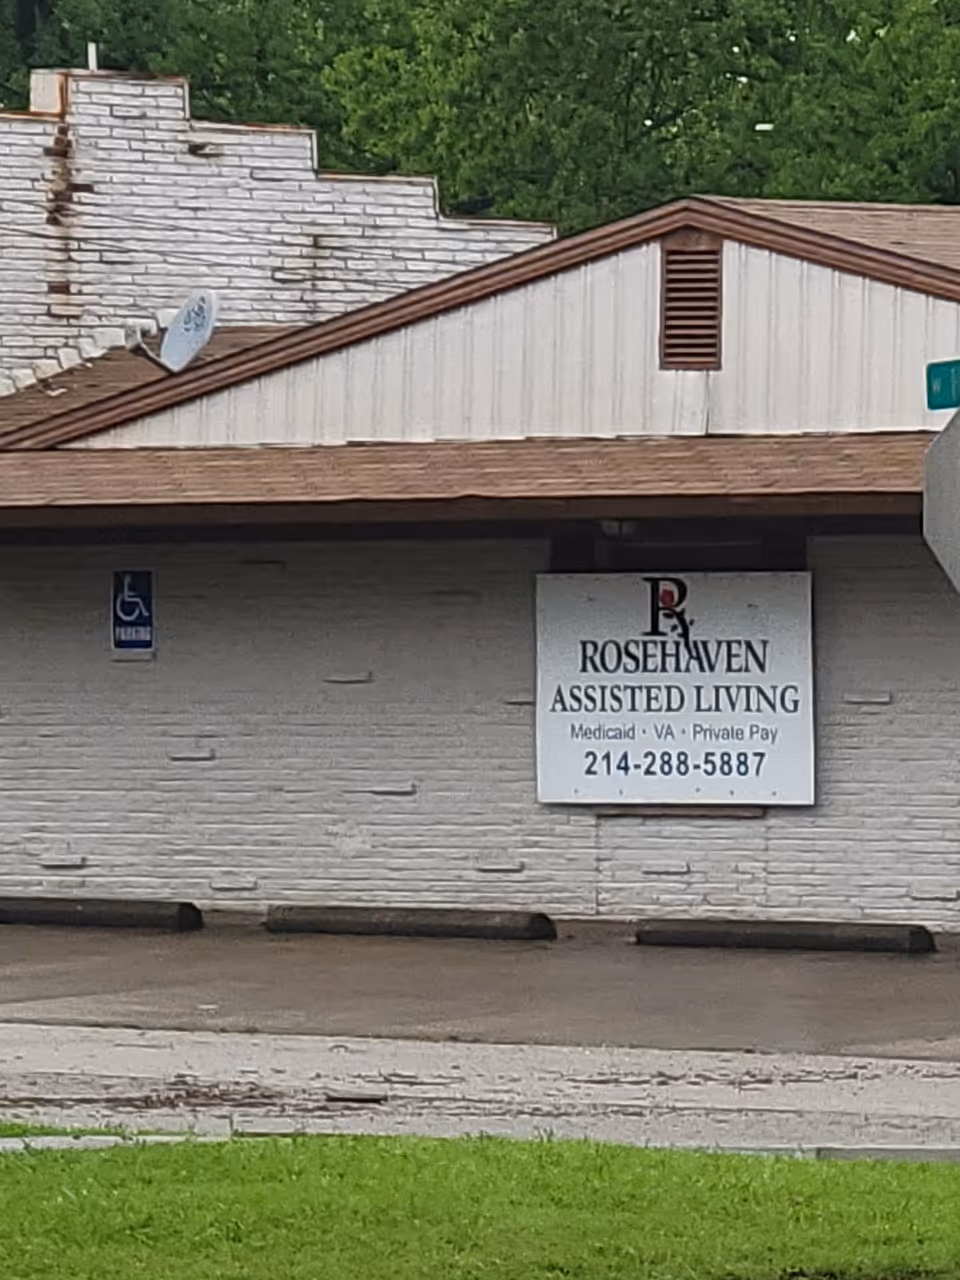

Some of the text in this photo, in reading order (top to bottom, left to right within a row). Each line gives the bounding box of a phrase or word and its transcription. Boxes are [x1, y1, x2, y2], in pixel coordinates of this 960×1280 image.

[579, 639, 769, 674] ROSEHAVEN
[549, 684, 801, 714] ASSISTED LIVING
[570, 723, 778, 745] Medicaid VA Private Pay
[583, 751, 767, 777] 214-288-5887
